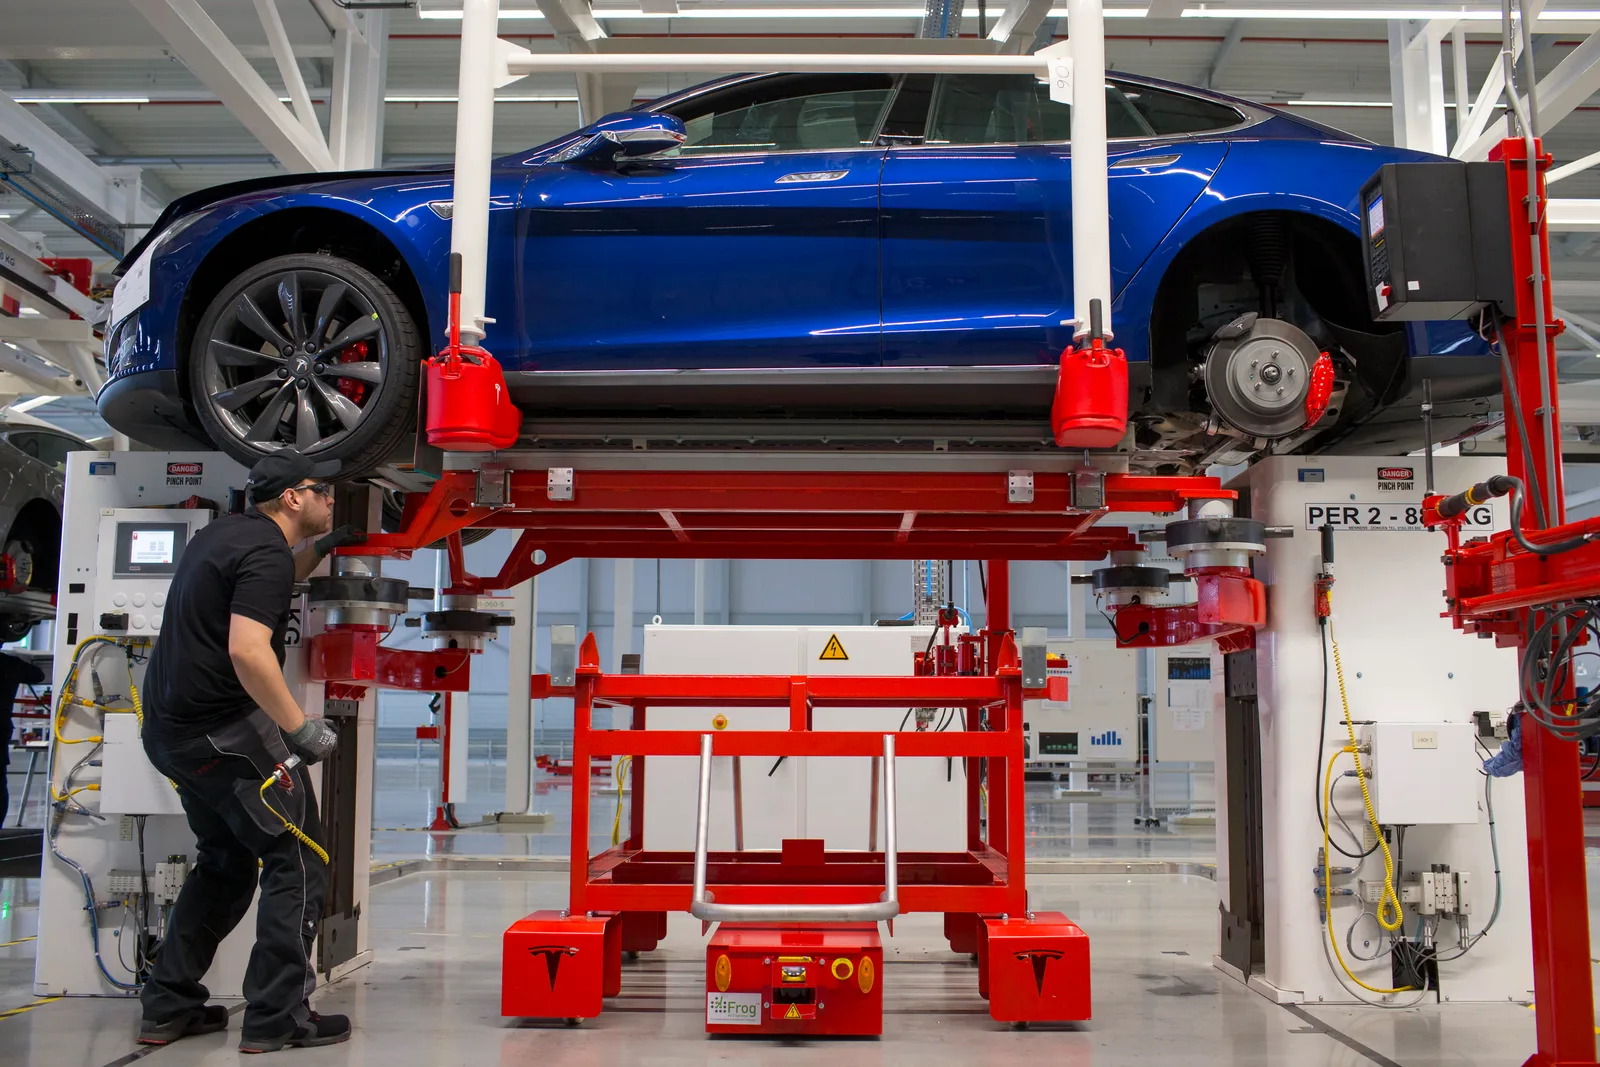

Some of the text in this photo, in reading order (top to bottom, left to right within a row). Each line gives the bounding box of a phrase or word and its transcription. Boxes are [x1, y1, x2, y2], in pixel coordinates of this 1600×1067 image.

[166, 477, 202, 485] PINCH POINT
[1378, 482, 1414, 490] PINCH POINT
[1309, 507, 1360, 524] PER
[1368, 507, 1381, 524] 2
[728, 1001, 756, 1017] Frog
